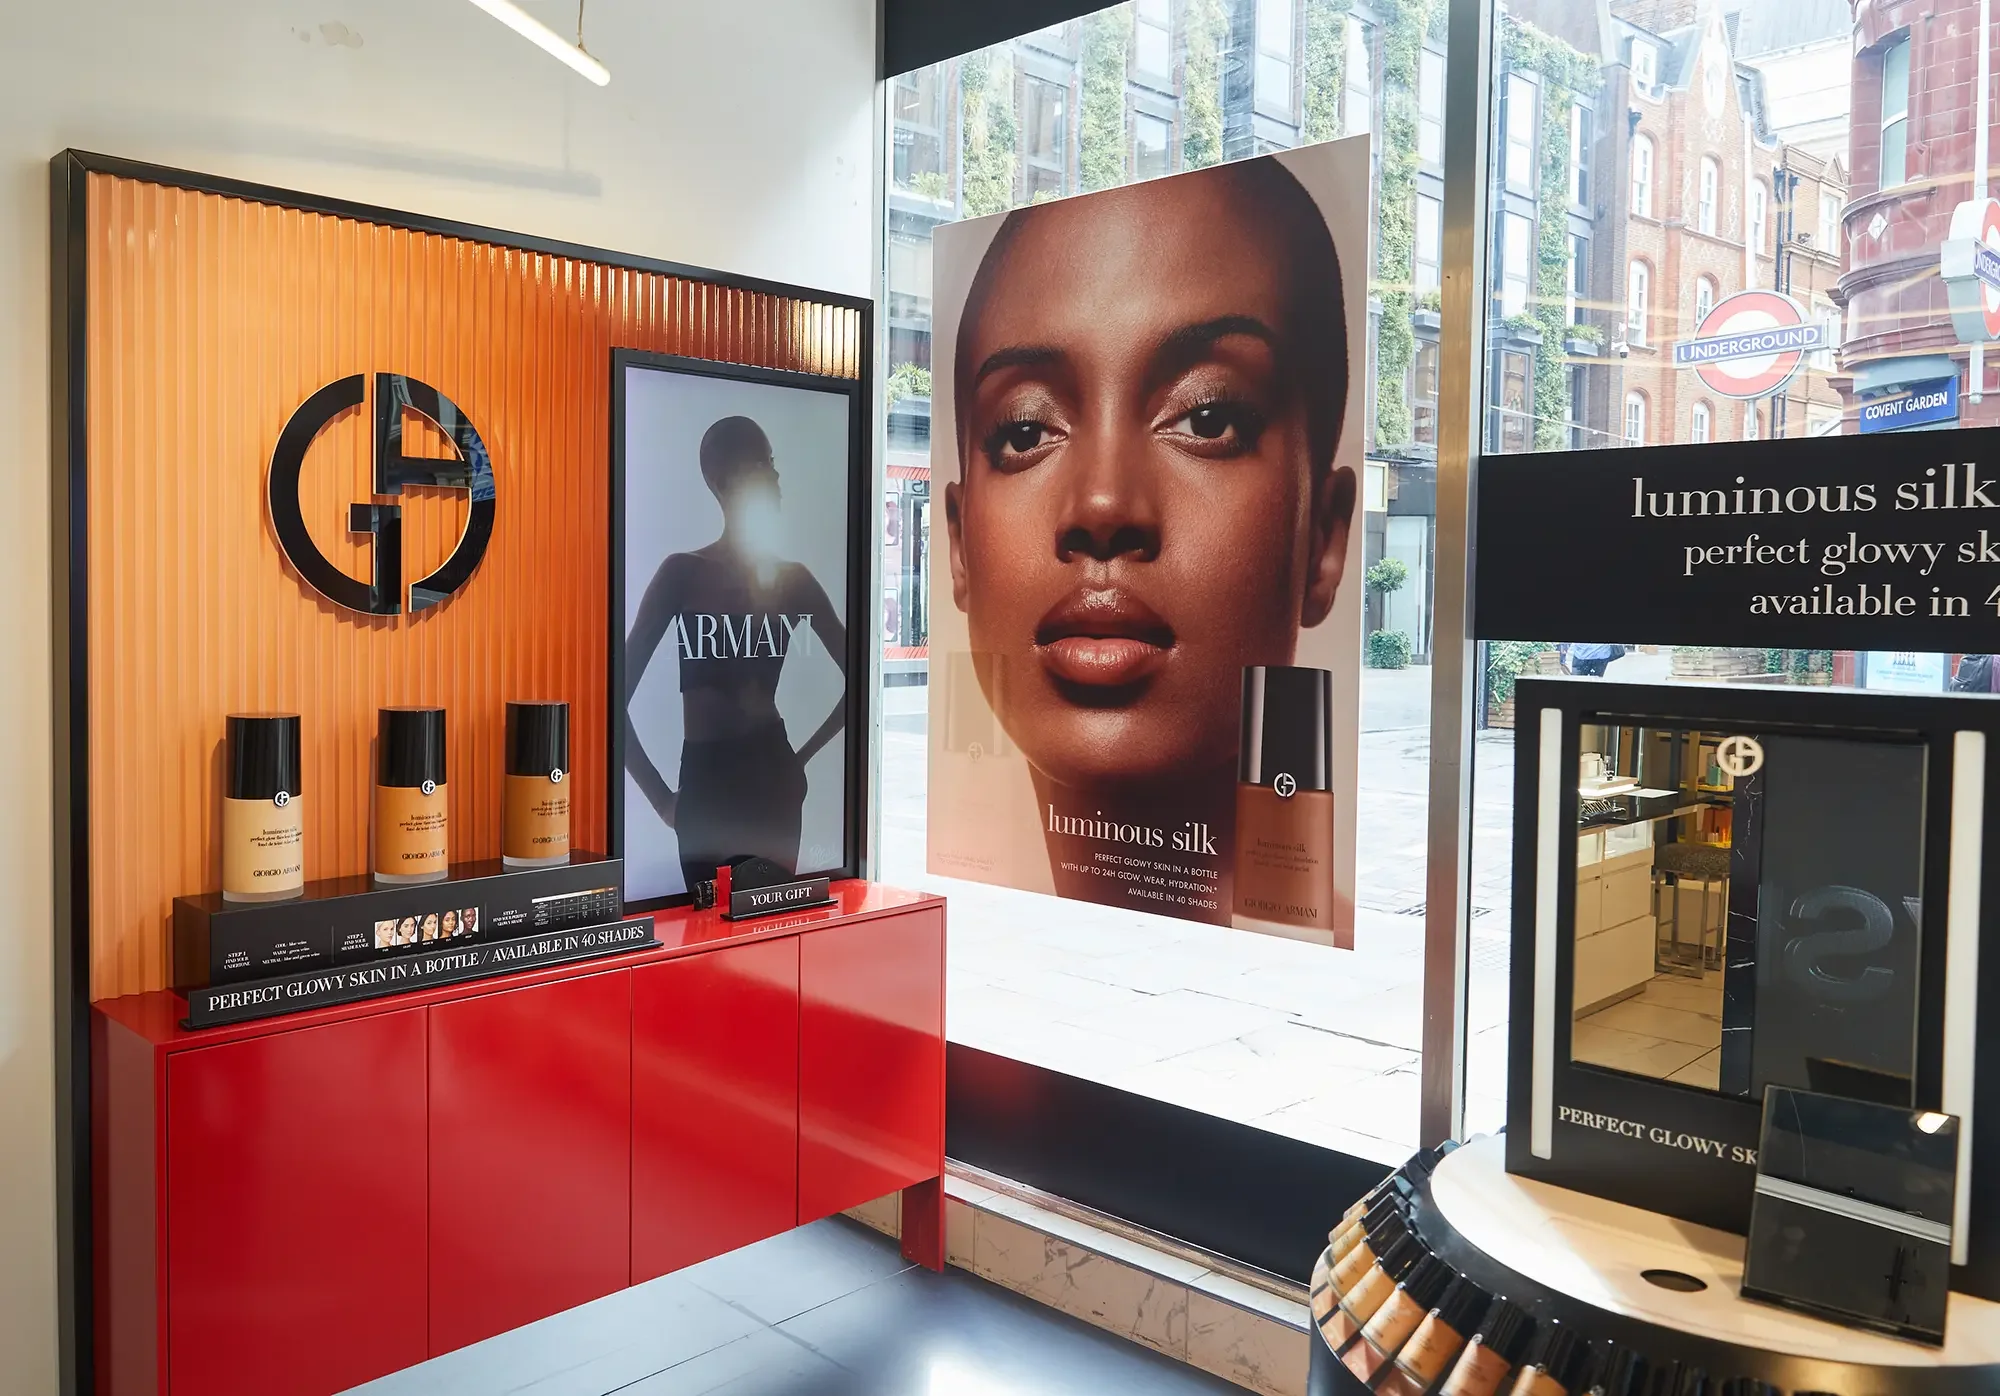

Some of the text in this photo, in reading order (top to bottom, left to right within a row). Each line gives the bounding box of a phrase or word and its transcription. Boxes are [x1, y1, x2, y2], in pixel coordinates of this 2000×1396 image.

[1679, 327, 1820, 361] UNDERGROUND
[1865, 391, 1948, 420] COVENT GARDEN
[1631, 462, 2000, 518] luminous silk
[1683, 529, 2000, 576] perfect glowy sk
[1749, 584, 1917, 616] available
[1928, 586, 1971, 617] in
[664, 613, 814, 660] ARMANI
[1047, 803, 1219, 856] luminous silk
[401, 852, 428, 860] GIORGIO
[1094, 852, 1218, 880] PERFECT GLOWY SKIN IN A BOTTLE
[253, 868, 281, 878] GIORGIO
[1060, 861, 1079, 872] WITH
[1080, 864, 1089, 874] UP
[1090, 866, 1101, 876] TO
[1102, 868, 1116, 878] 24H
[1143, 875, 1167, 887] WEAR,
[750, 886, 813, 906] YOUR GIFT
[1127, 887, 1218, 910] AVAILABLE IN 40 SHADES
[1285, 904, 1318, 919] ARMANI
[208, 985, 284, 1012] PERFECT
[286, 974, 347, 998] GLOWY
[349, 968, 387, 987] SKIN
[390, 964, 408, 981] IN
[410, 963, 422, 977] A
[425, 952, 479, 975] BOTTLE
[491, 938, 562, 963] AVAILABLE
[564, 935, 580, 950] IN
[581, 933, 596, 947] 40
[597, 925, 645, 946] SHADES
[1558, 1105, 1646, 1139] PERFECT
[1649, 1127, 1728, 1159] GLOWY
